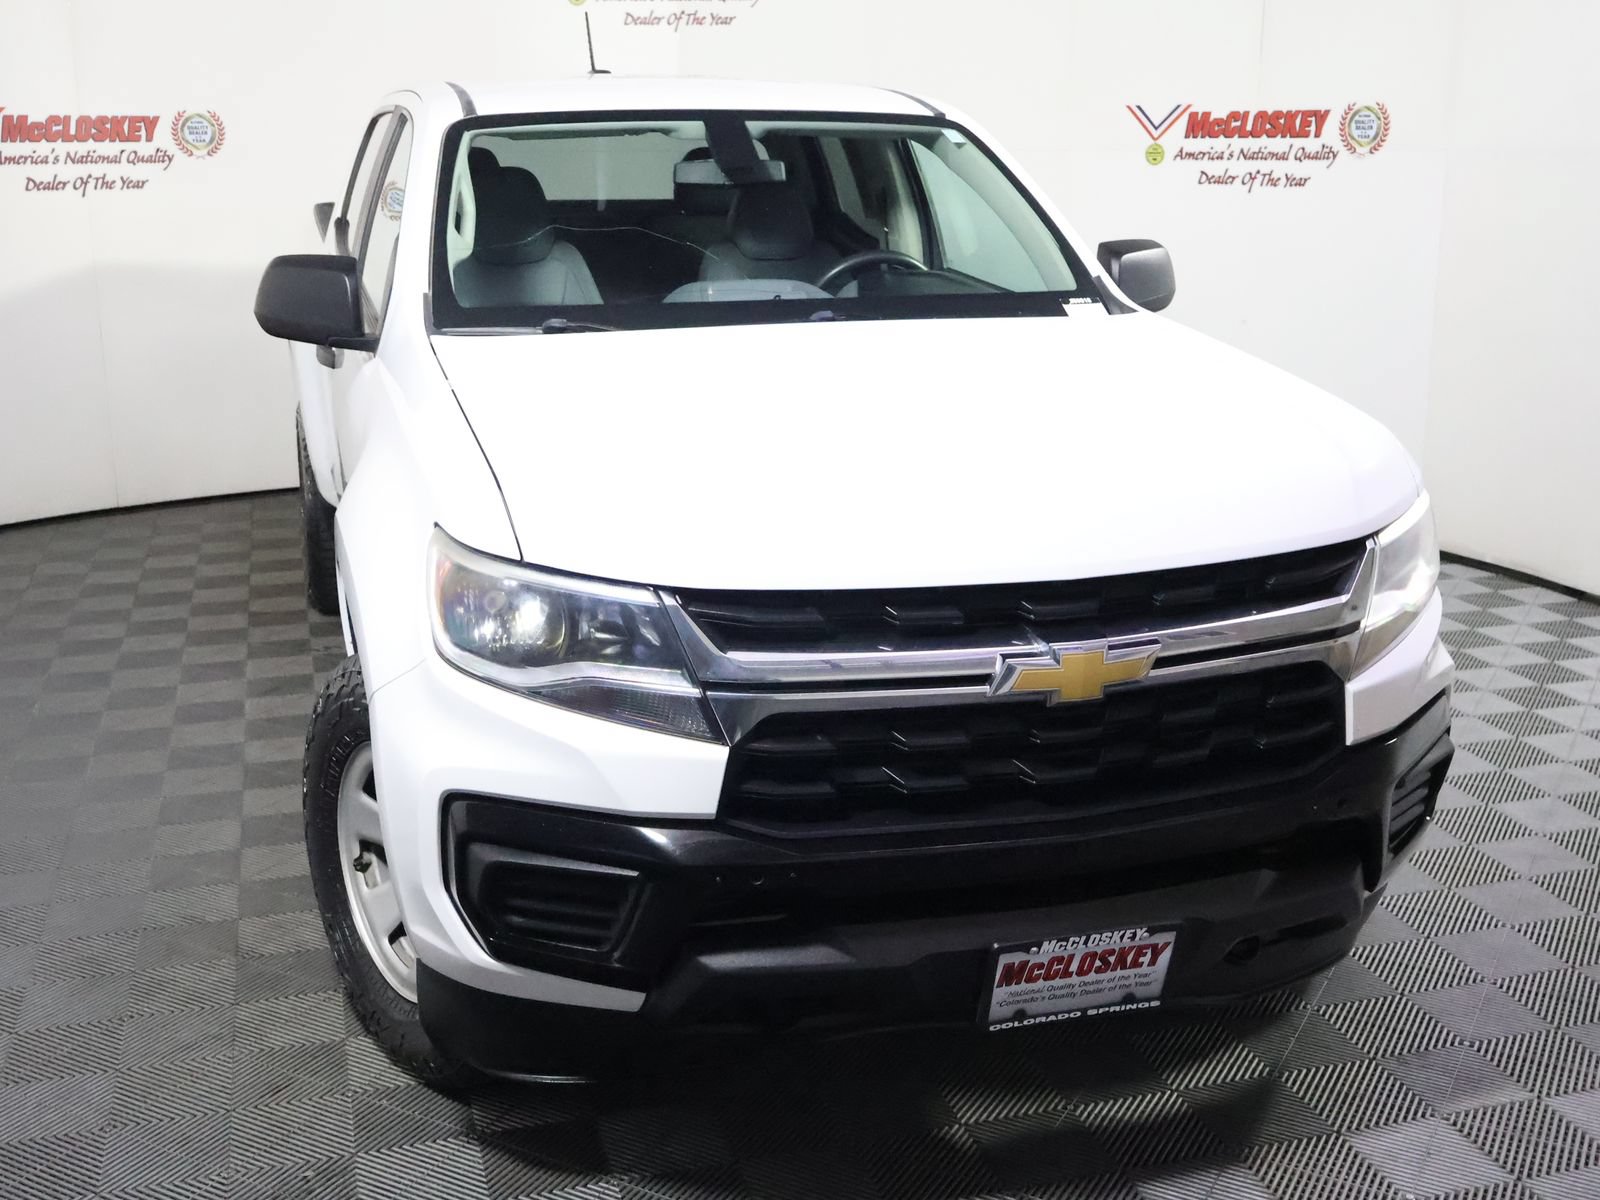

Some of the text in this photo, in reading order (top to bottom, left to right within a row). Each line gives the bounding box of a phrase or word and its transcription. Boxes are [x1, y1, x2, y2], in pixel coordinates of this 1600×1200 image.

[623, 9, 736, 32] Dealer Of The Year
[1, 115, 160, 143] McCLOSKEY
[1185, 109, 1331, 139] McCLOSKEY
[65, 148, 124, 166] National
[126, 148, 175, 171] Quality
[1173, 143, 1234, 162] America's
[1238, 143, 1290, 162] National
[1293, 143, 1339, 168] Quality
[25, 173, 149, 198] Dealer Of The Year
[1198, 169, 1311, 193] Dealer Of The Year
[1039, 927, 1148, 955] McCLOSKEY
[996, 941, 1172, 988] McCLOSKEY
[1047, 983, 1077, 993] Quality
[1078, 977, 1105, 988] Dealer
[1107, 975, 1117, 984] of
[1117, 974, 1131, 982] the
[1048, 991, 1078, 1001] Quality
[1079, 986, 1106, 997] Dealer
[989, 1000, 1162, 1032] COLORADO SPRINGS
